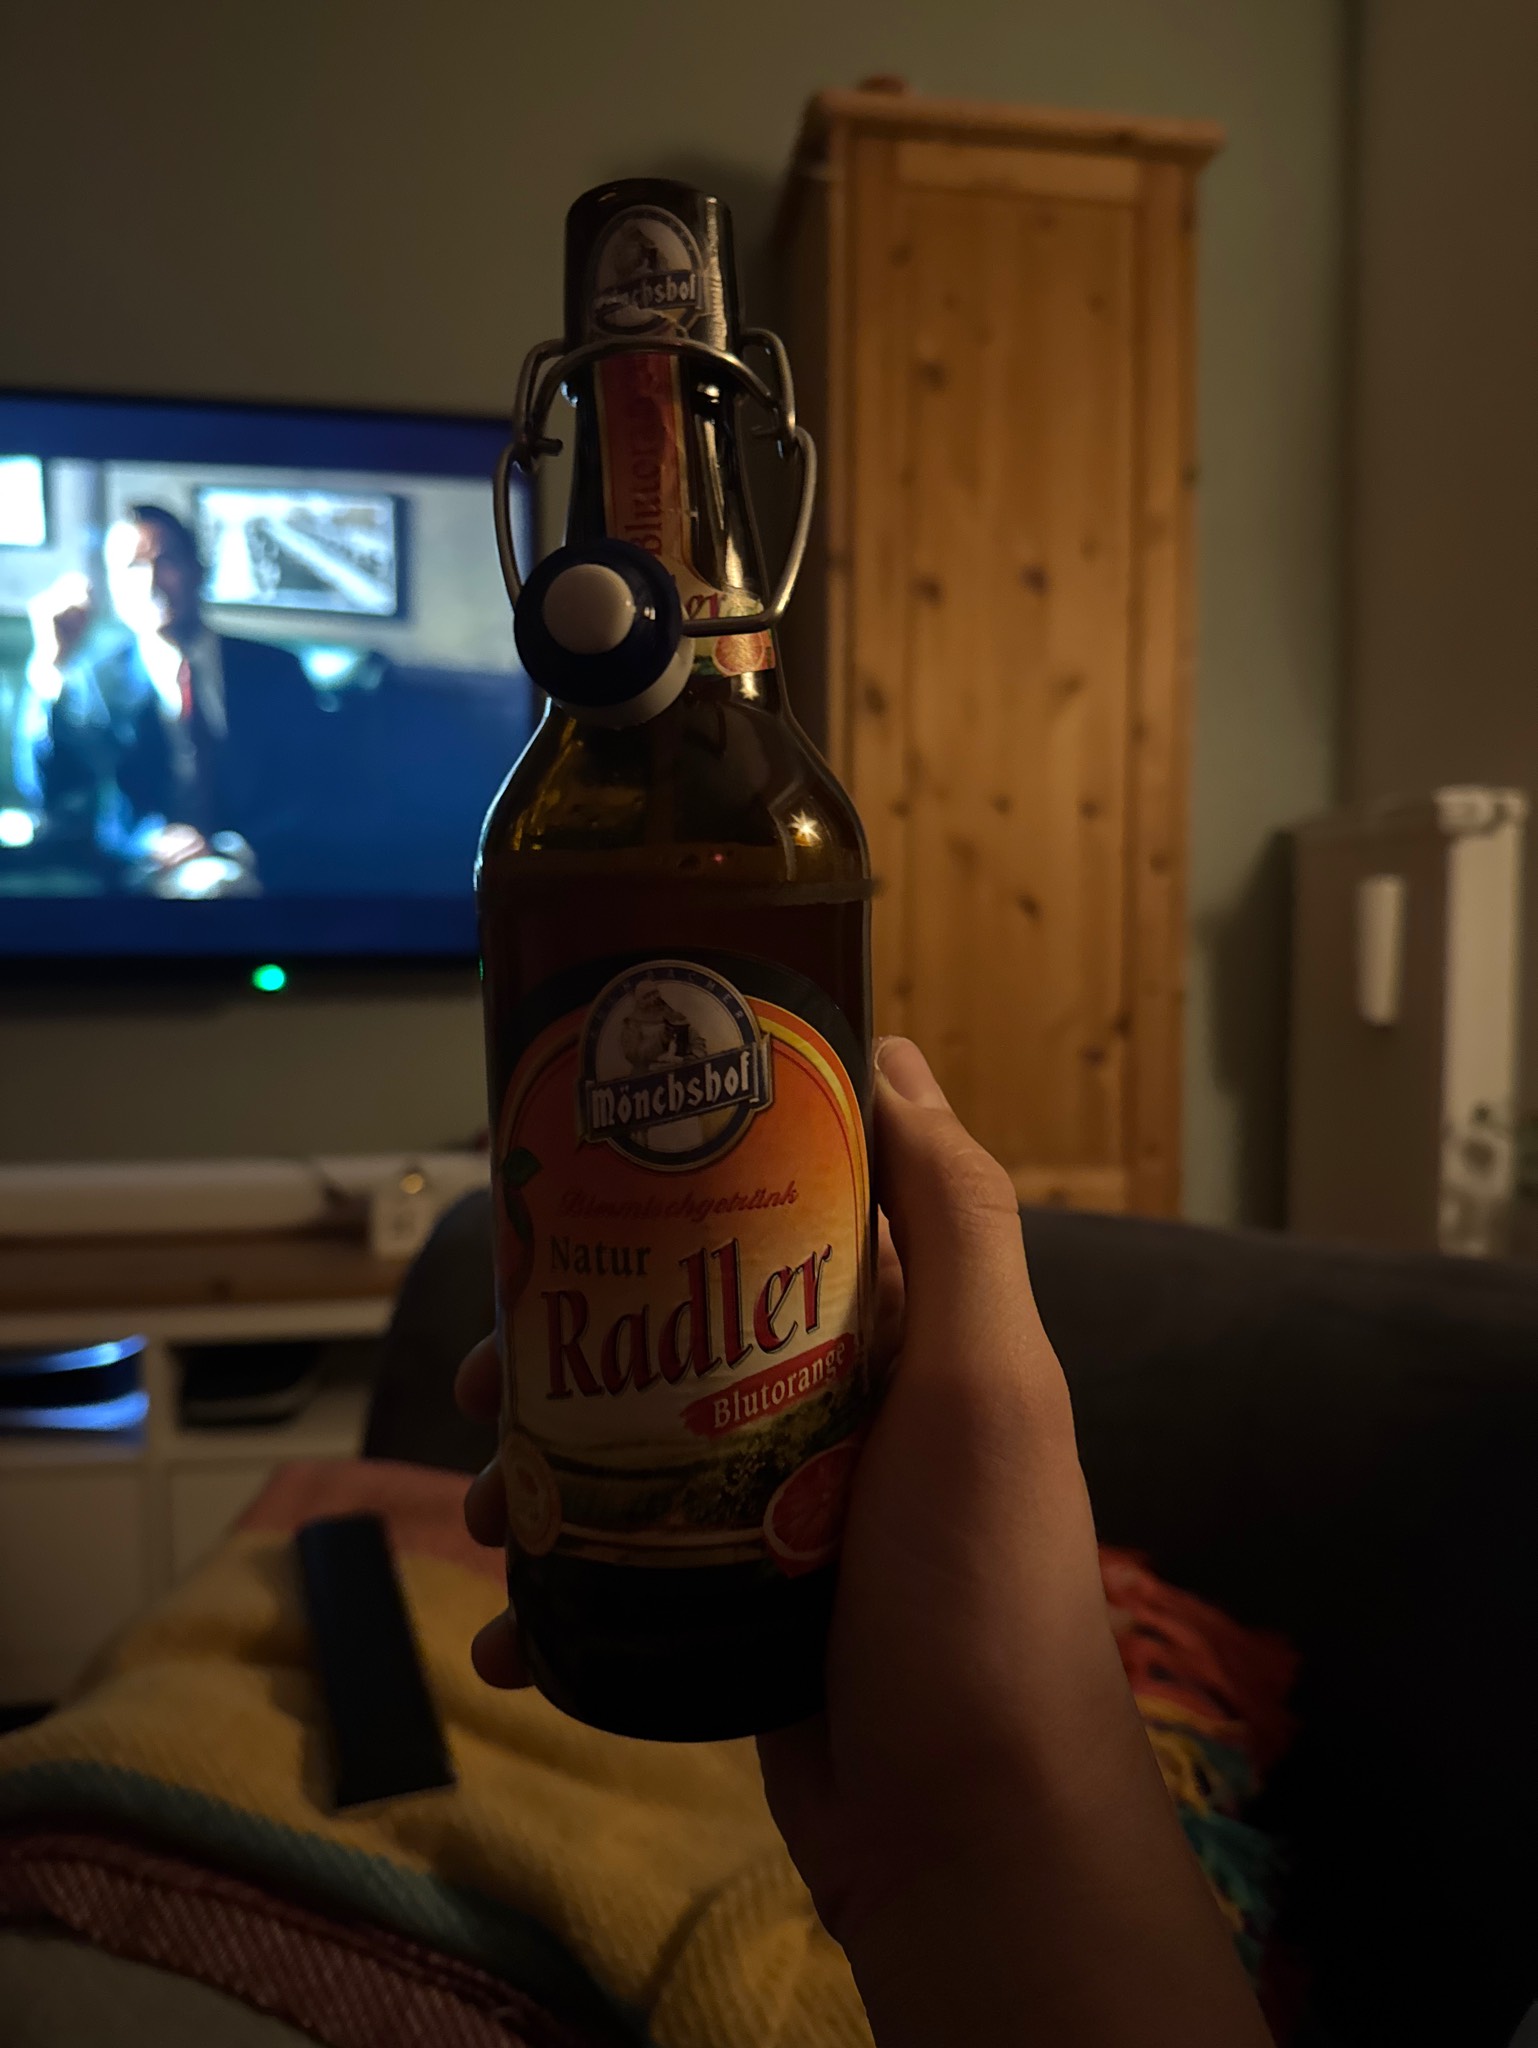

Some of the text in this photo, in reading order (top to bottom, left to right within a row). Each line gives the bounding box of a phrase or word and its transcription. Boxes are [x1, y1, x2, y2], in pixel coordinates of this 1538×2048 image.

[592, 1051, 751, 1129] Mönchshof
[550, 1236, 652, 1276] Natur
[541, 1238, 832, 1400] Radler
[713, 1342, 846, 1431] Blutorange
